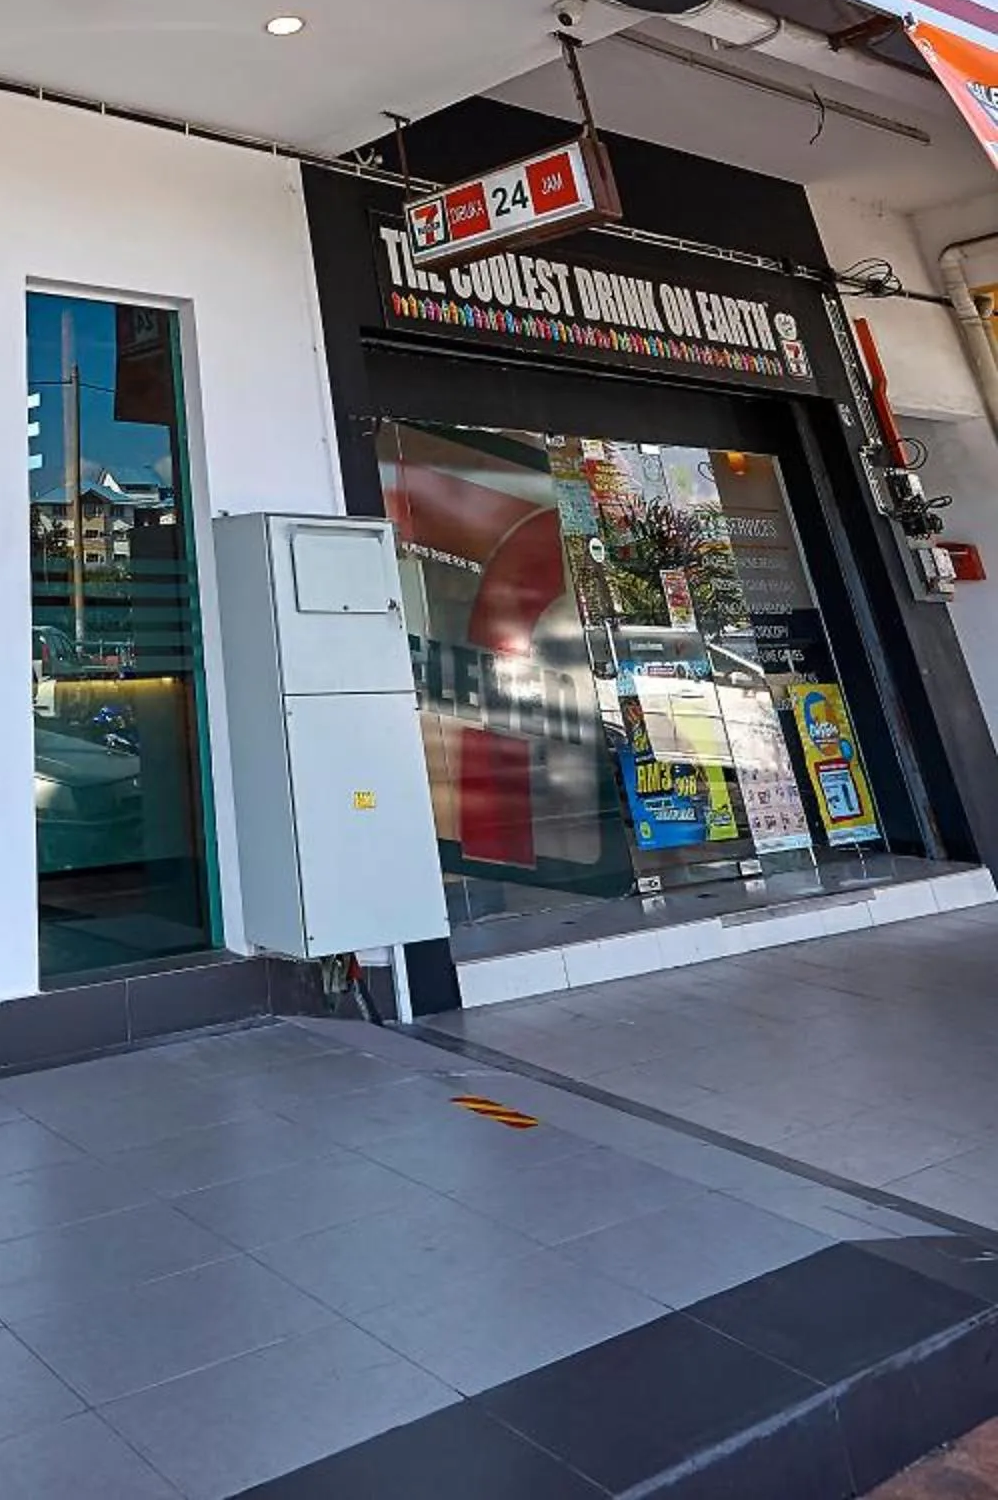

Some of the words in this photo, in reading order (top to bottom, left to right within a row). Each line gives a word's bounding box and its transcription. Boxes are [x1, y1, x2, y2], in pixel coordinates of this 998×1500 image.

[450, 199, 485, 224] DIBUKA
[492, 180, 528, 217] 24
[541, 172, 563, 195] JAM
[573, 266, 664, 333] DRINK
[659, 283, 702, 339] ON
[695, 290, 777, 351] EARTH
